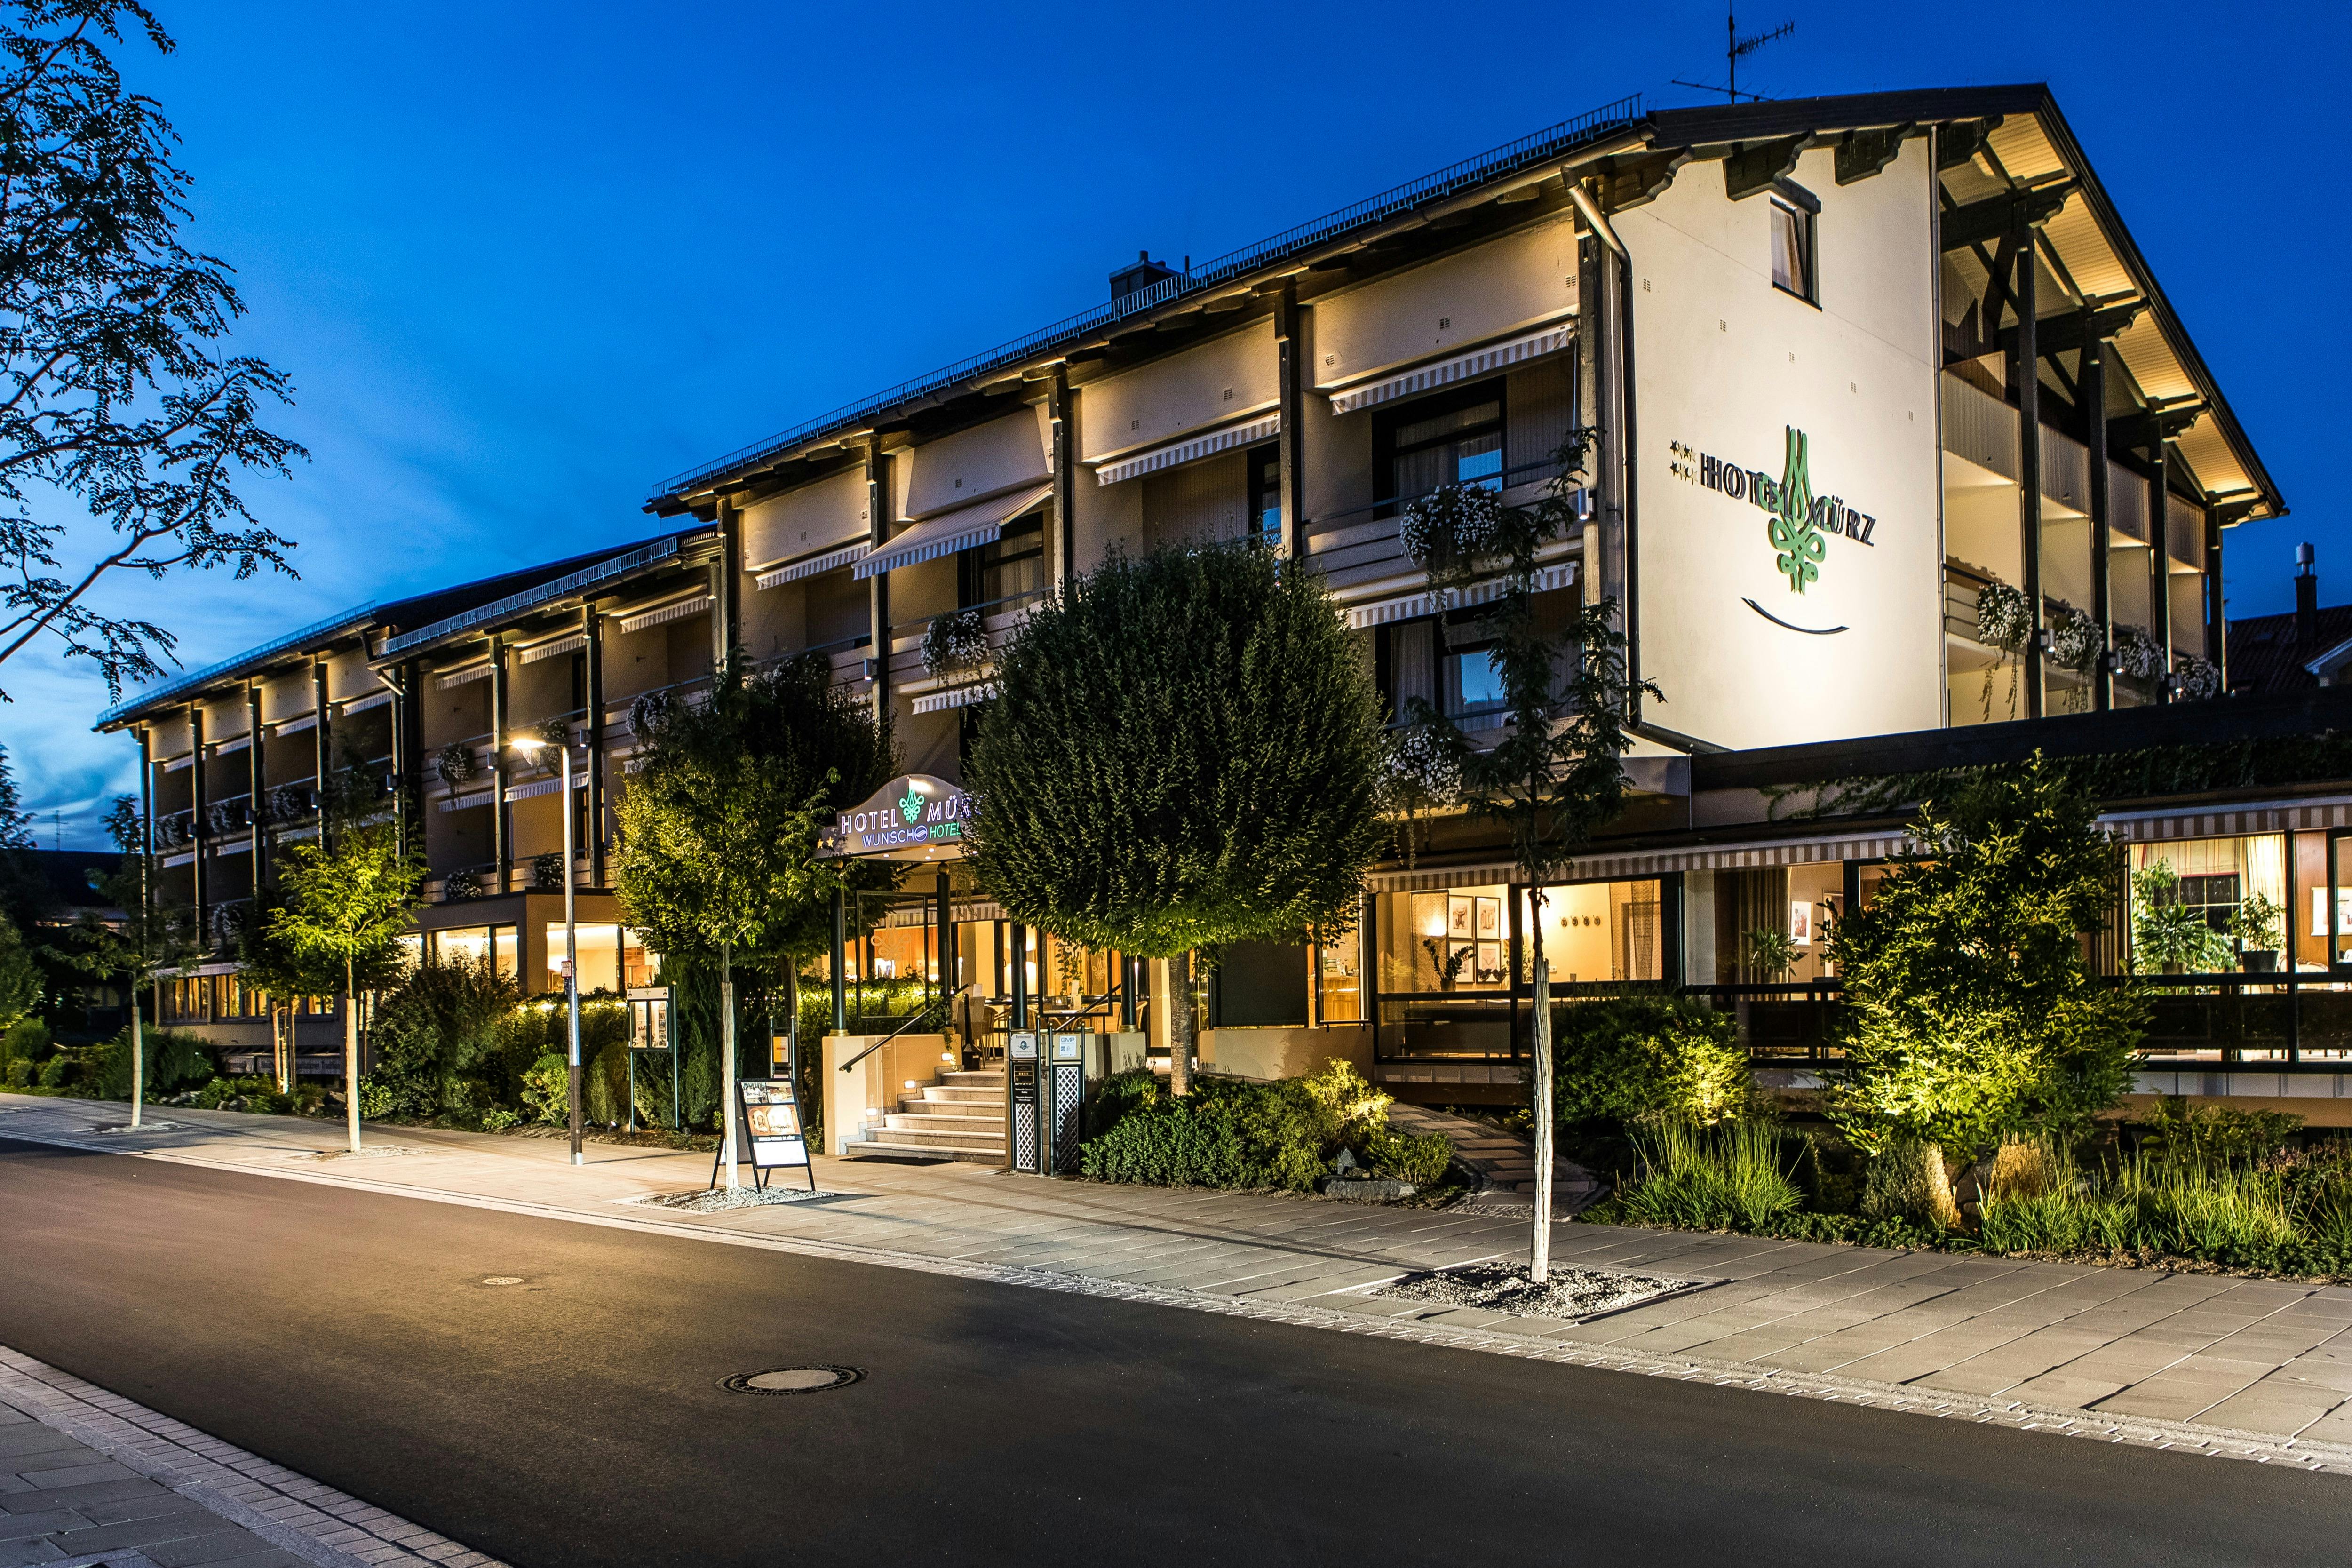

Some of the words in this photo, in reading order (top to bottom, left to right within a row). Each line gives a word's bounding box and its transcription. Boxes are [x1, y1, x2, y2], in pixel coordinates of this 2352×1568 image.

[1700, 452, 1793, 519] HOTEL
[1805, 494, 1877, 547] MÜRZ
[841, 808, 899, 835] HOTEL
[861, 828, 914, 848] WUNSCH
[929, 822, 961, 839] HOTEL
